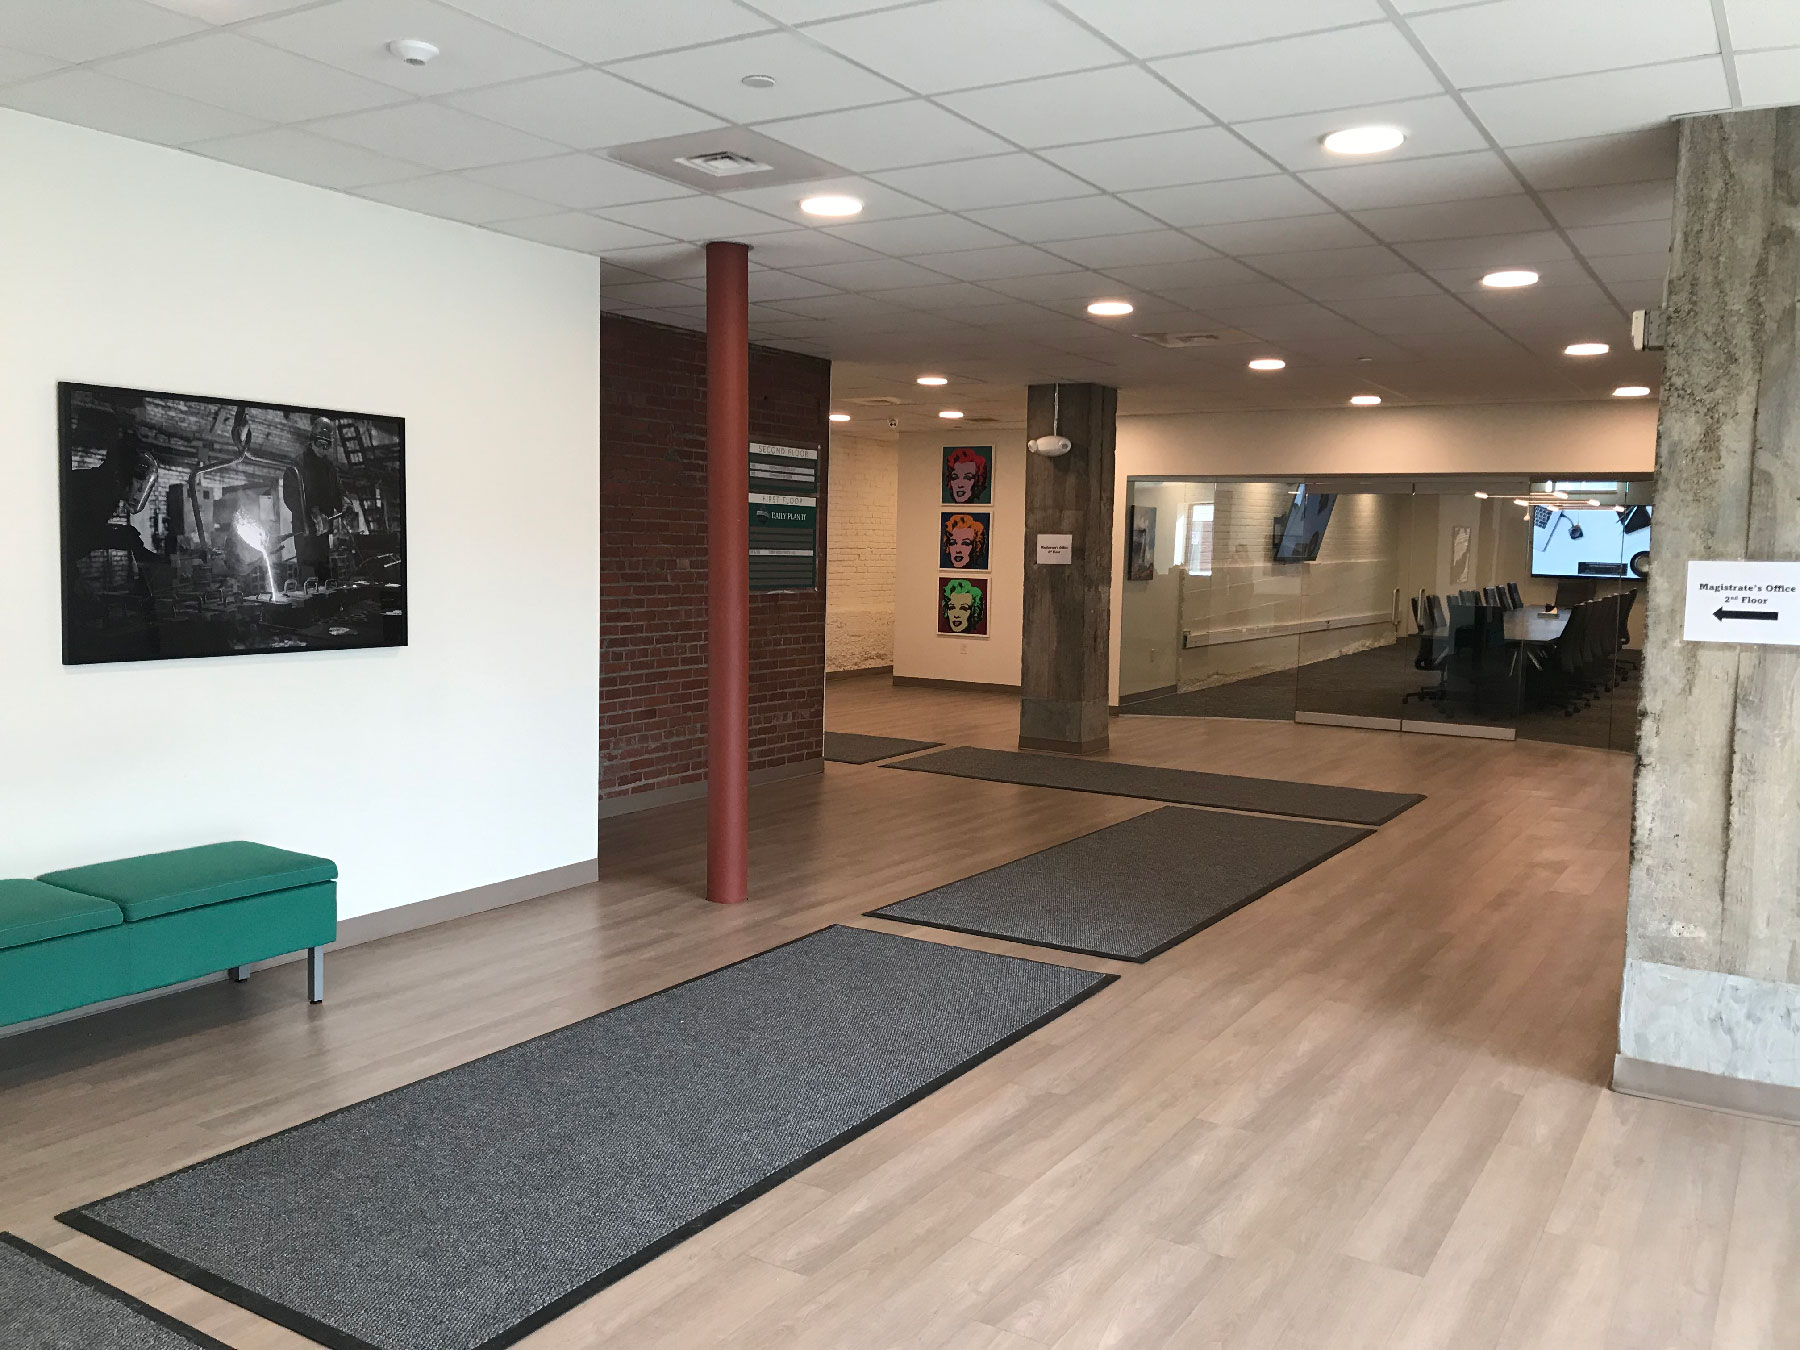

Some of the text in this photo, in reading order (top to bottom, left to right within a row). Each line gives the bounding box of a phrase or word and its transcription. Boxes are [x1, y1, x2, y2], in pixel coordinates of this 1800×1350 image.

[758, 445, 809, 458] SECOND FLOOR
[771, 511, 788, 520] DAILY
[1699, 583, 1797, 593] Magistrate's Office
[1741, 596, 1768, 604] Floor
